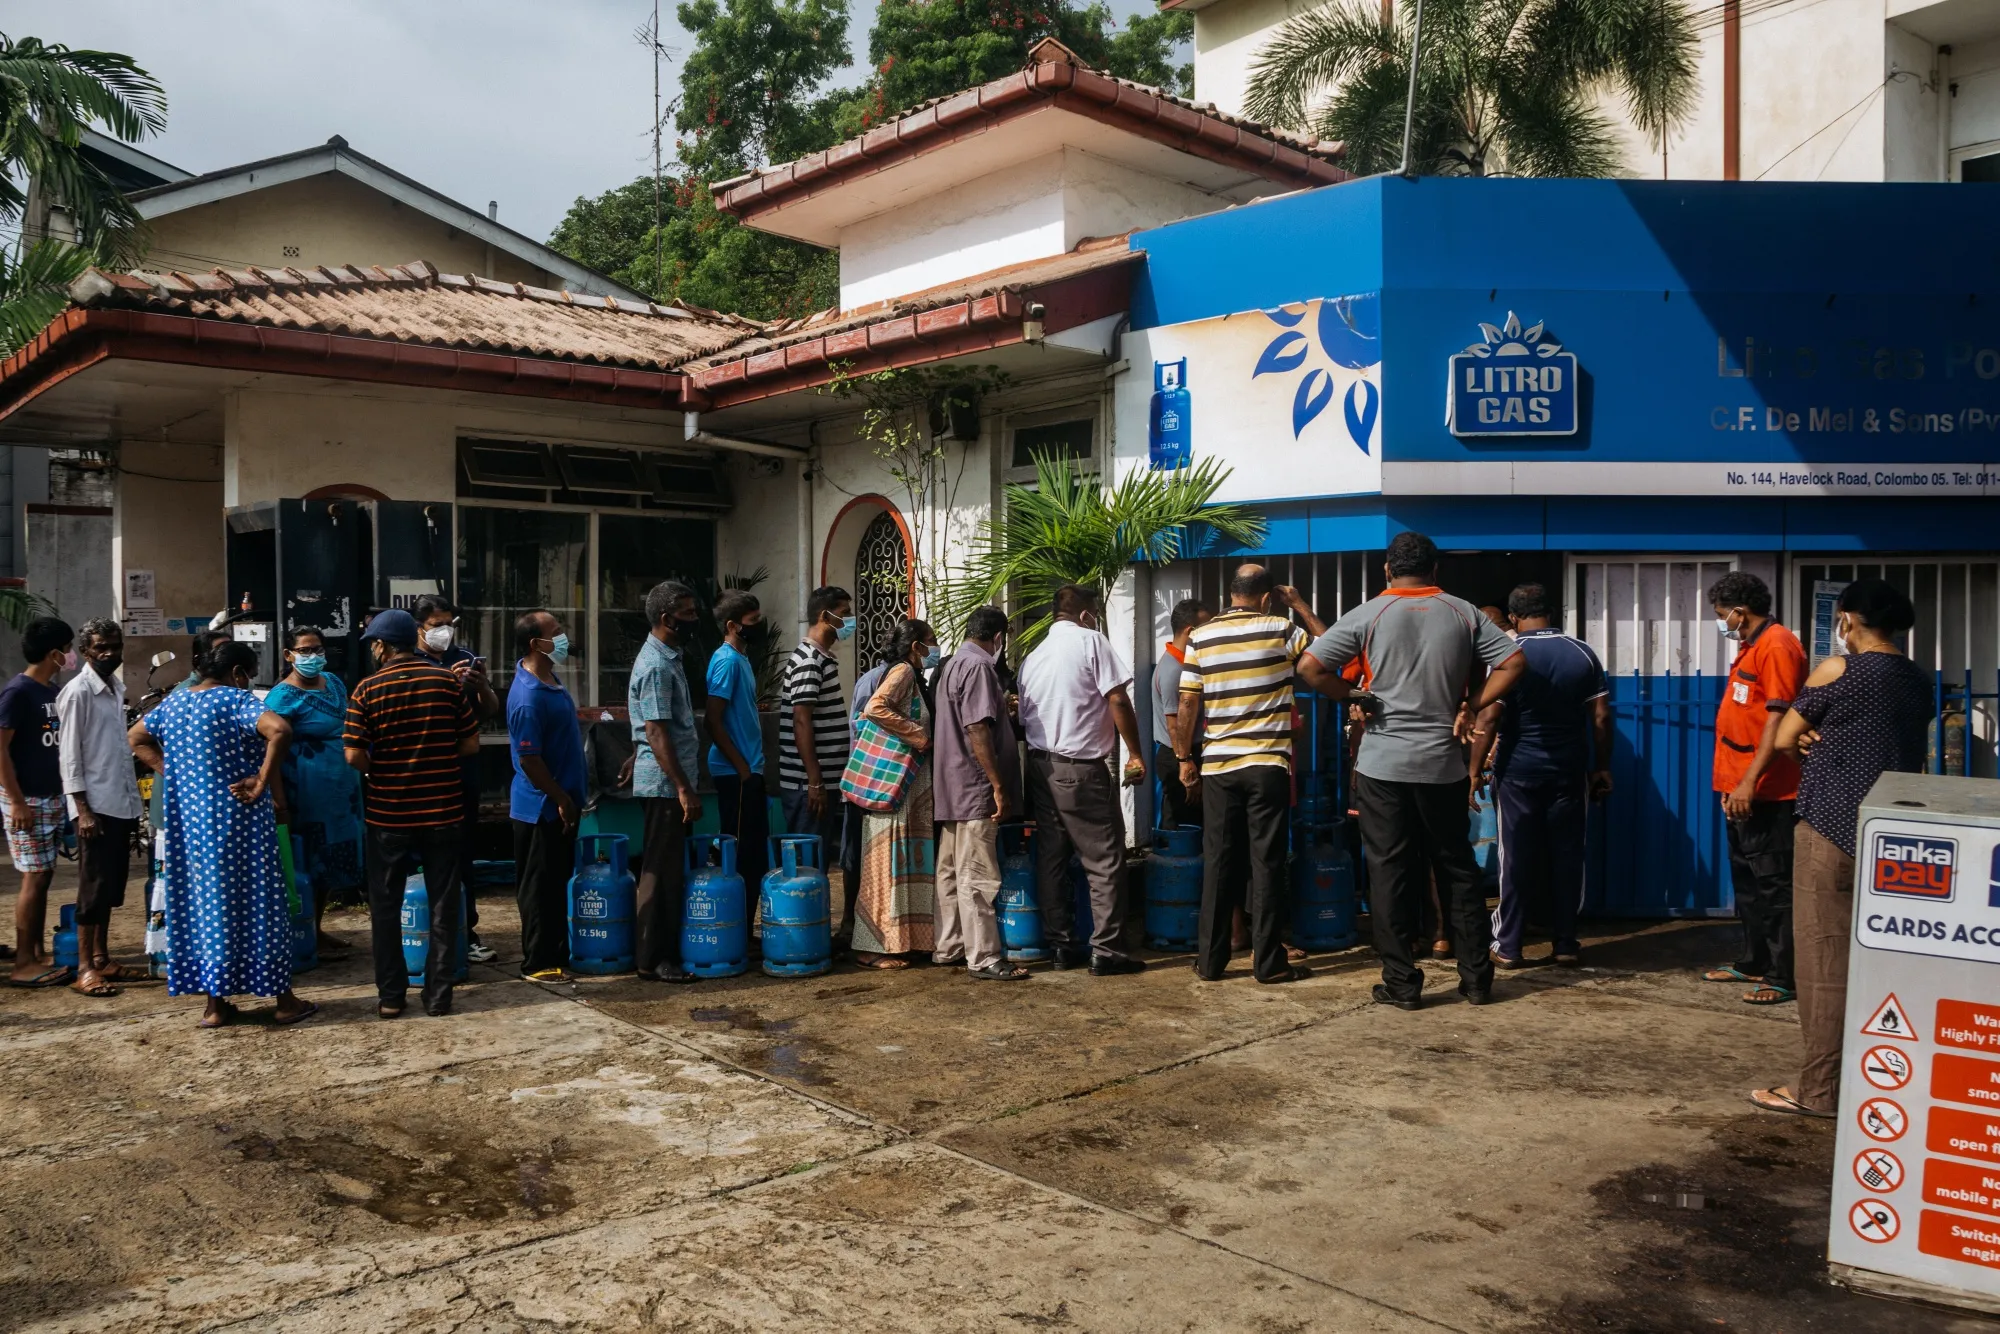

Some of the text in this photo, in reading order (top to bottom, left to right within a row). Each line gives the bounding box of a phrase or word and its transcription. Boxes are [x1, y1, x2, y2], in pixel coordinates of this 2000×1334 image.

[1945, 339, 2000, 379] Po
[1466, 366, 1562, 393] LITRO
[1478, 396, 1551, 424] GAS
[1711, 406, 1757, 432] C.F.
[1765, 406, 1801, 433] De
[1809, 406, 1854, 433] Mel
[1862, 406, 1881, 433] &
[1889, 406, 1954, 434] Sons
[1171, 442, 1179, 450] kg
[1727, 472, 1747, 485] No.
[1751, 472, 1776, 487] 144,
[1779, 472, 1833, 485] Havelock
[1837, 472, 1871, 487] Road,
[1875, 472, 1928, 486] Colombo
[1932, 472, 1949, 486] 05.
[1952, 472, 1973, 486] Tel:
[1877, 838, 1952, 865] lanka
[1875, 859, 1951, 896] pay
[580, 901, 603, 909] LITRO
[583, 908, 600, 916] GAS
[690, 902, 712, 911] LITRO
[692, 909, 708, 917] GAS
[1867, 914, 2000, 946] CARDS ACC
[688, 934, 718, 945] 12.5 kg
[1941, 1027, 1986, 1046] Highly
[1967, 1088, 2000, 1101] smo
[1986, 1124, 2000, 1137] N
[1949, 1137, 1988, 1153] open
[1936, 1187, 1989, 1205] mobile
[1951, 1225, 2000, 1246] Switch
